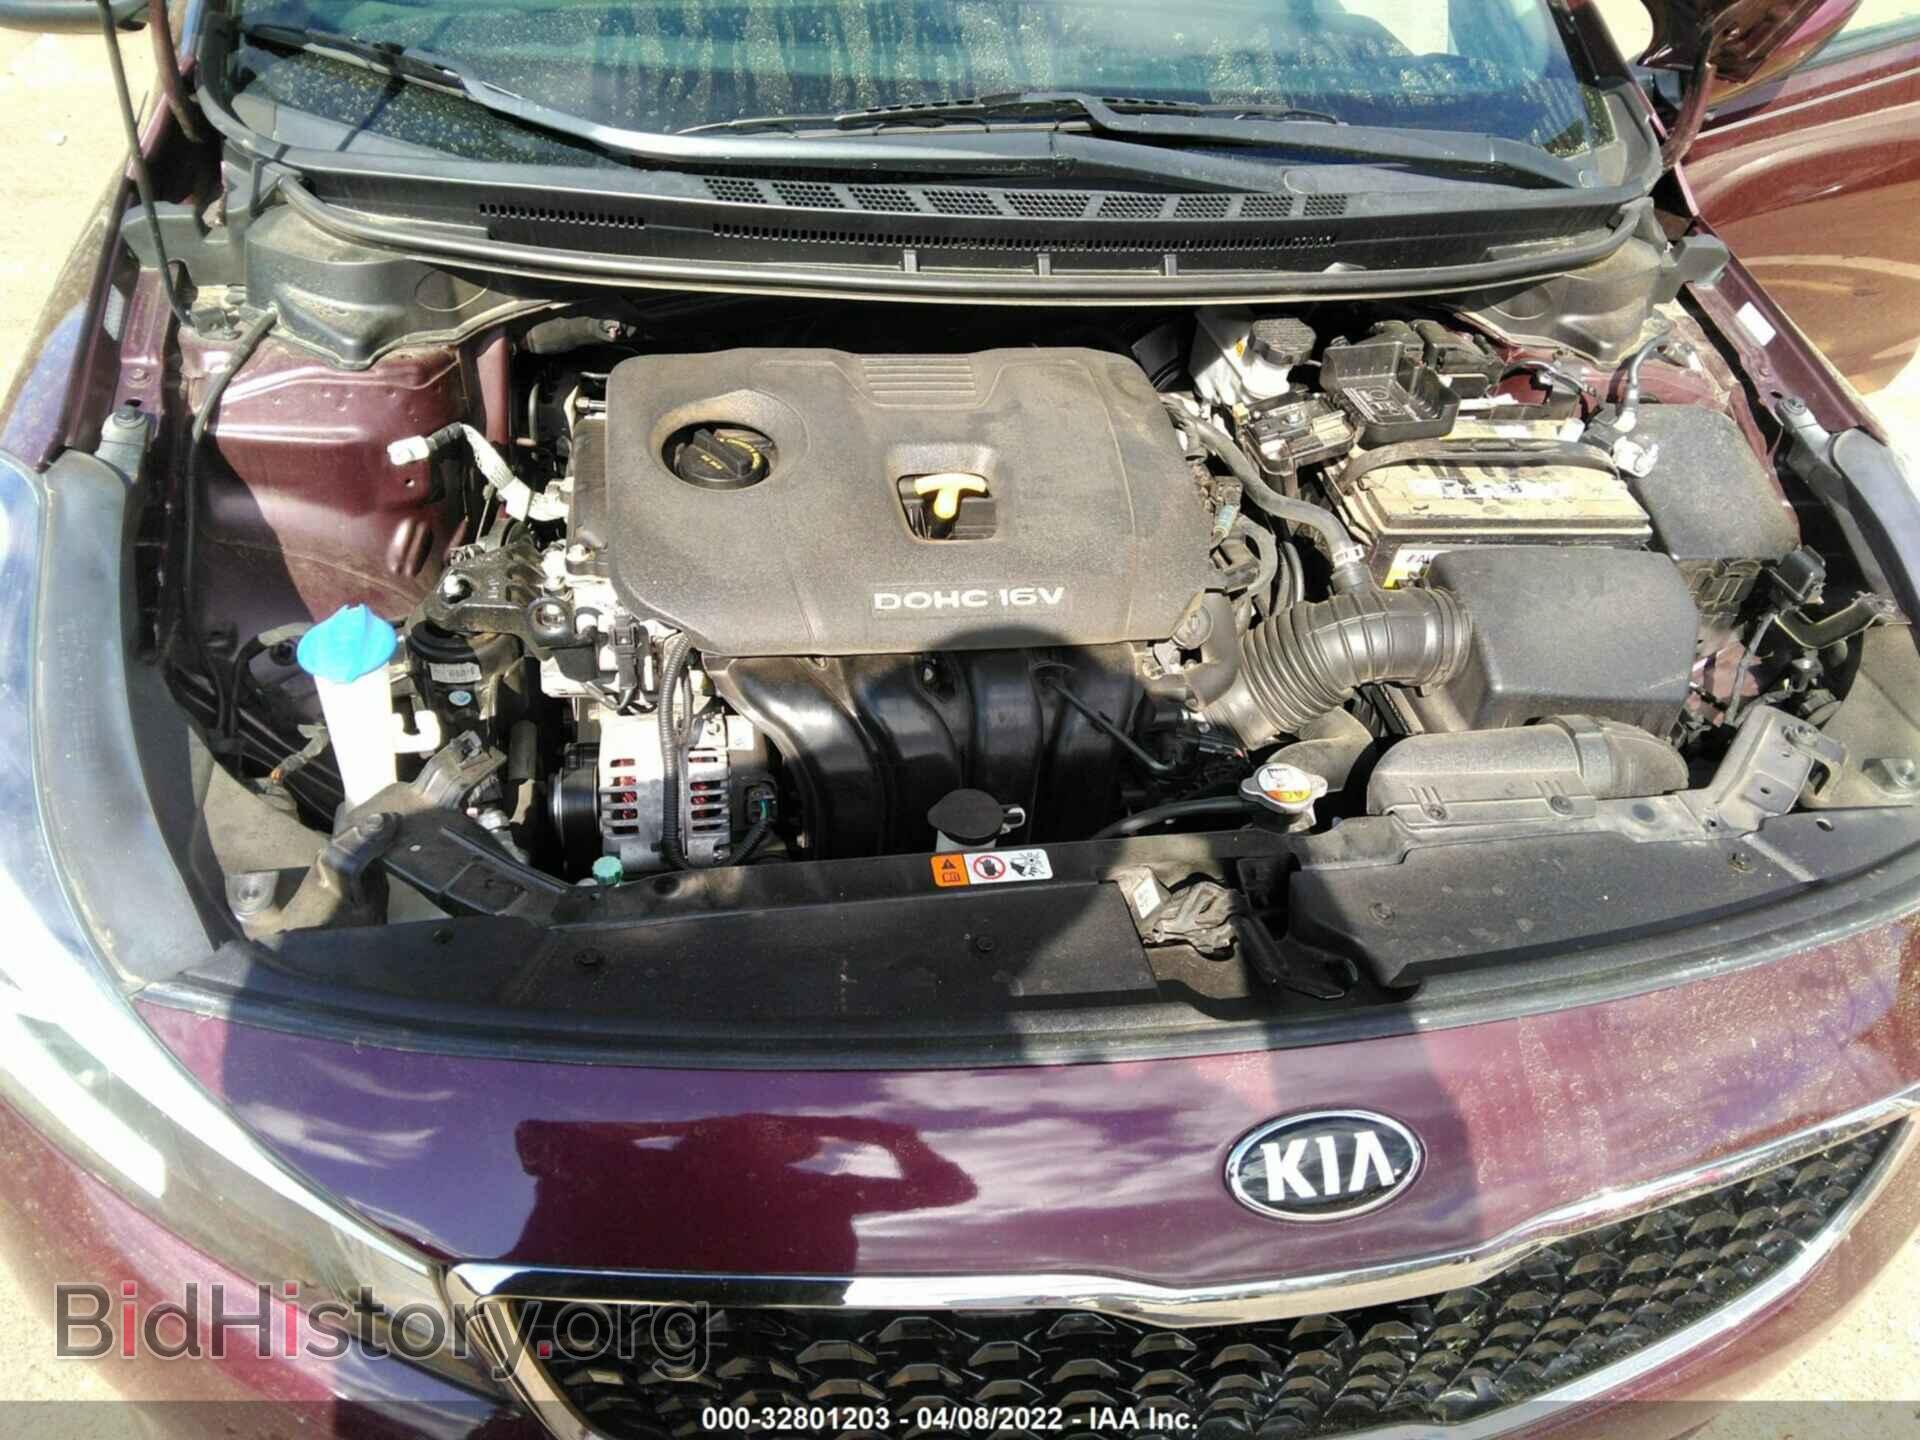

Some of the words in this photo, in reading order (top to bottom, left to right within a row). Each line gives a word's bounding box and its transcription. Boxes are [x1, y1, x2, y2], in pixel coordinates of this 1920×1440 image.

[873, 589, 988, 610] DOHC
[998, 586, 1065, 607] 16V
[1260, 1130, 1396, 1201] KIA
